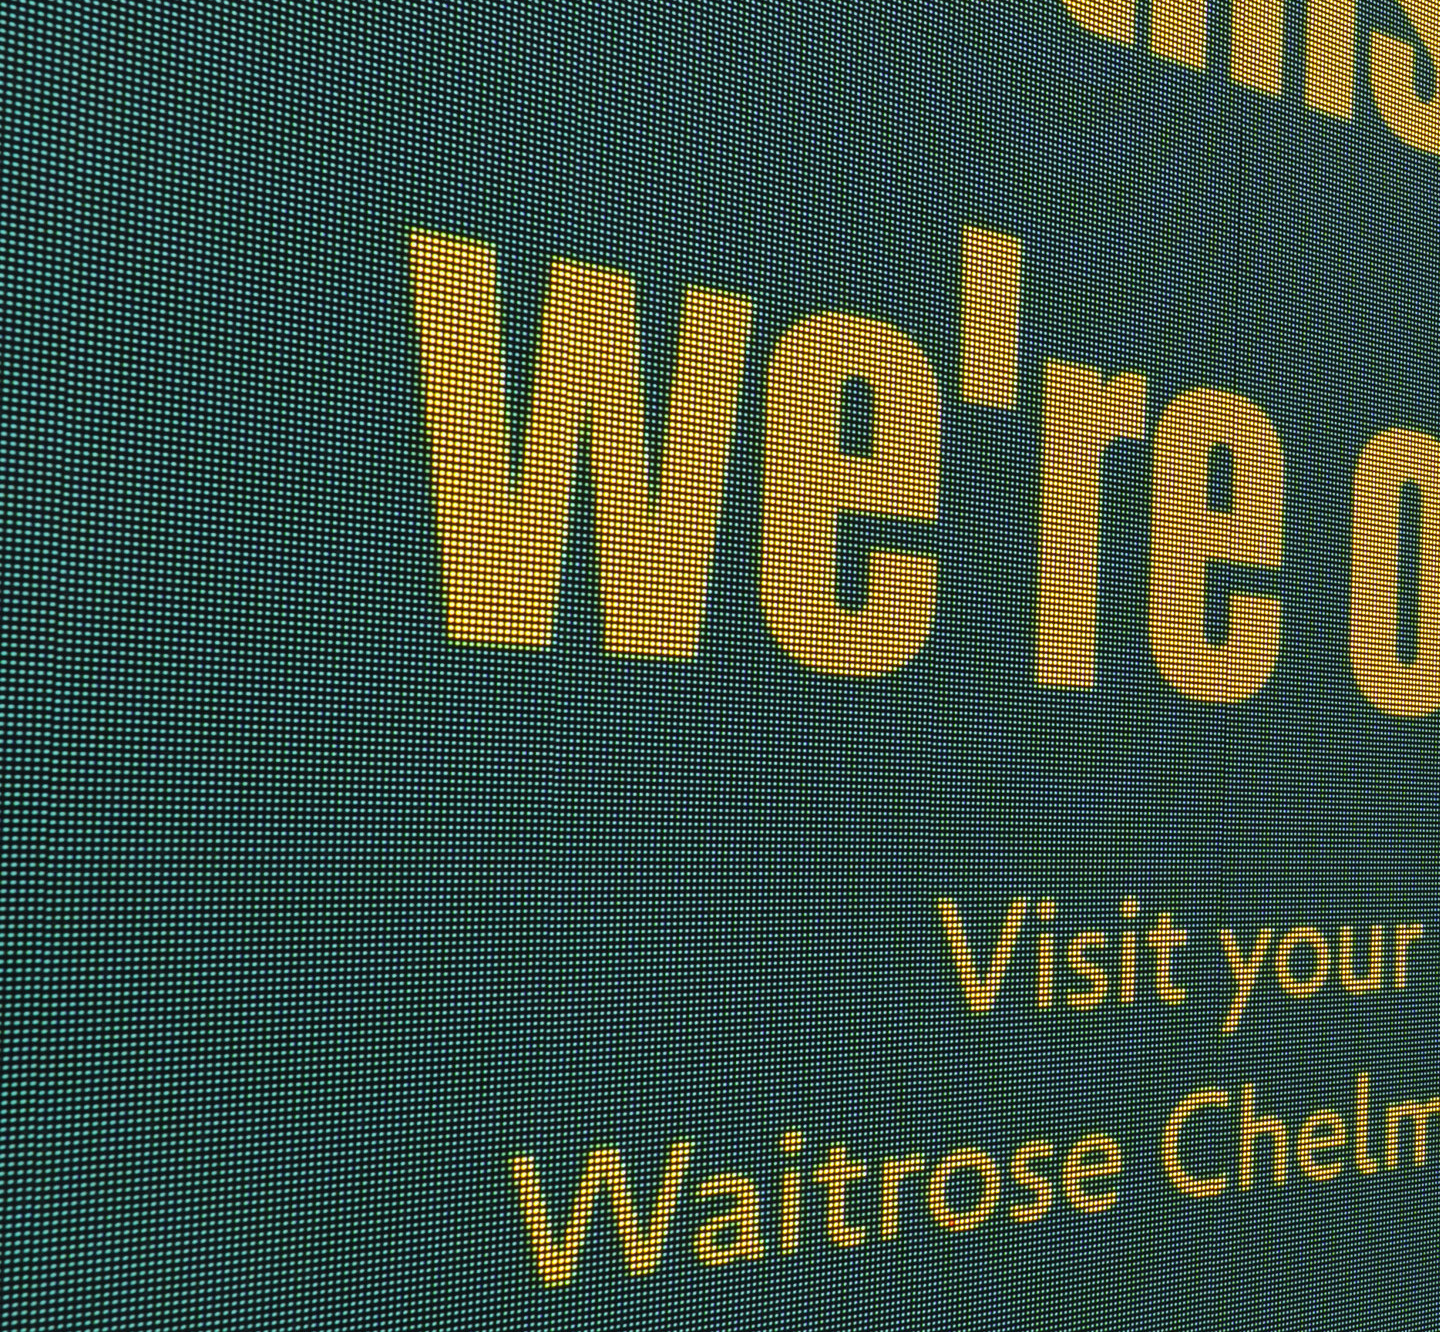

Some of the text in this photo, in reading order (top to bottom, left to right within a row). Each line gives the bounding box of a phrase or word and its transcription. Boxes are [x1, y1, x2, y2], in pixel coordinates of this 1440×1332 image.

[409, 222, 1286, 705] we're
[938, 896, 1189, 1015] Visit
[1219, 915, 1424, 1033] your
[510, 1130, 1124, 1288] Waitrose
